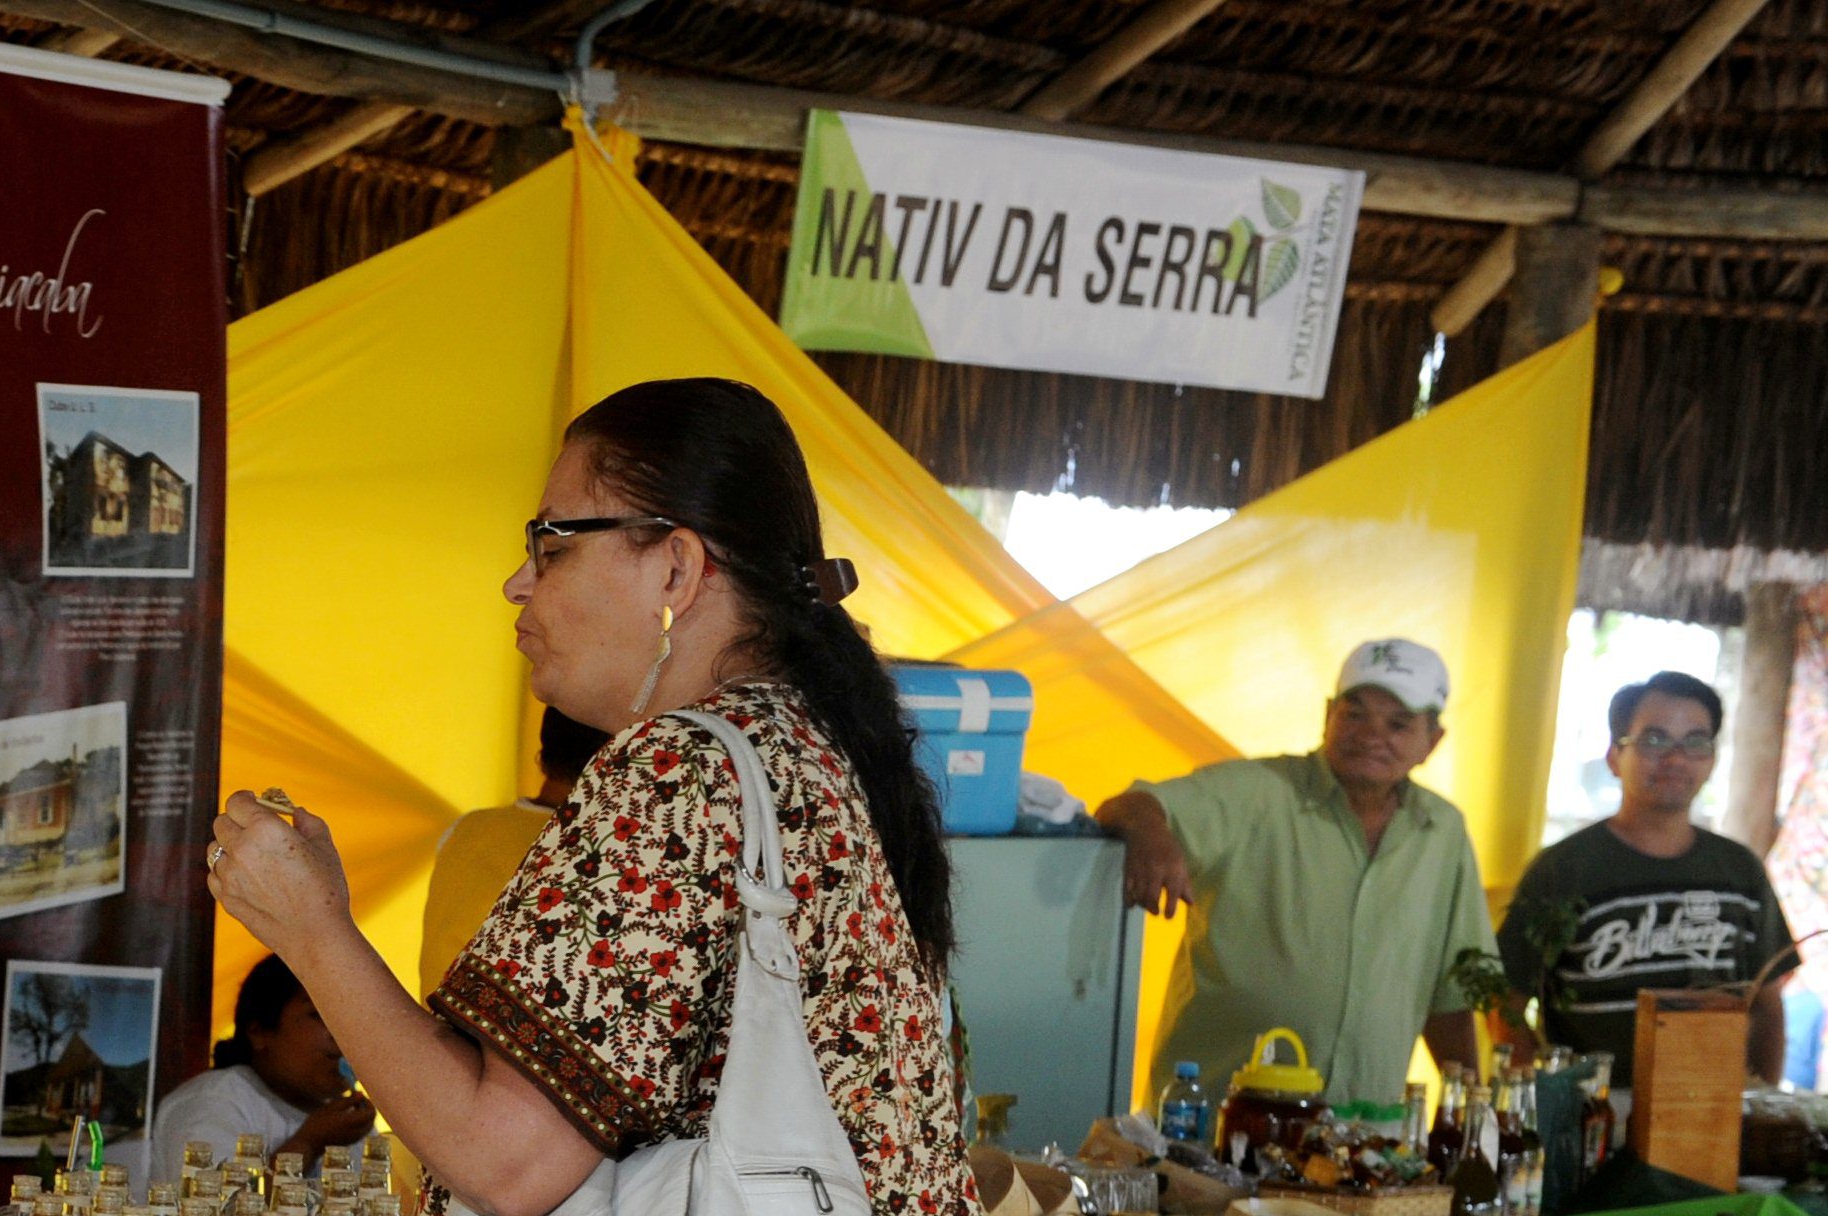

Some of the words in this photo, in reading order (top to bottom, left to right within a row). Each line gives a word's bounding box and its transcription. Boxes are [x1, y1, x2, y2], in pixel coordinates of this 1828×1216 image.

[811, 187, 982, 288] NATIV
[987, 207, 1068, 298] DA
[1084, 216, 1265, 318] SERRA
[1317, 182, 1343, 244] MATA
